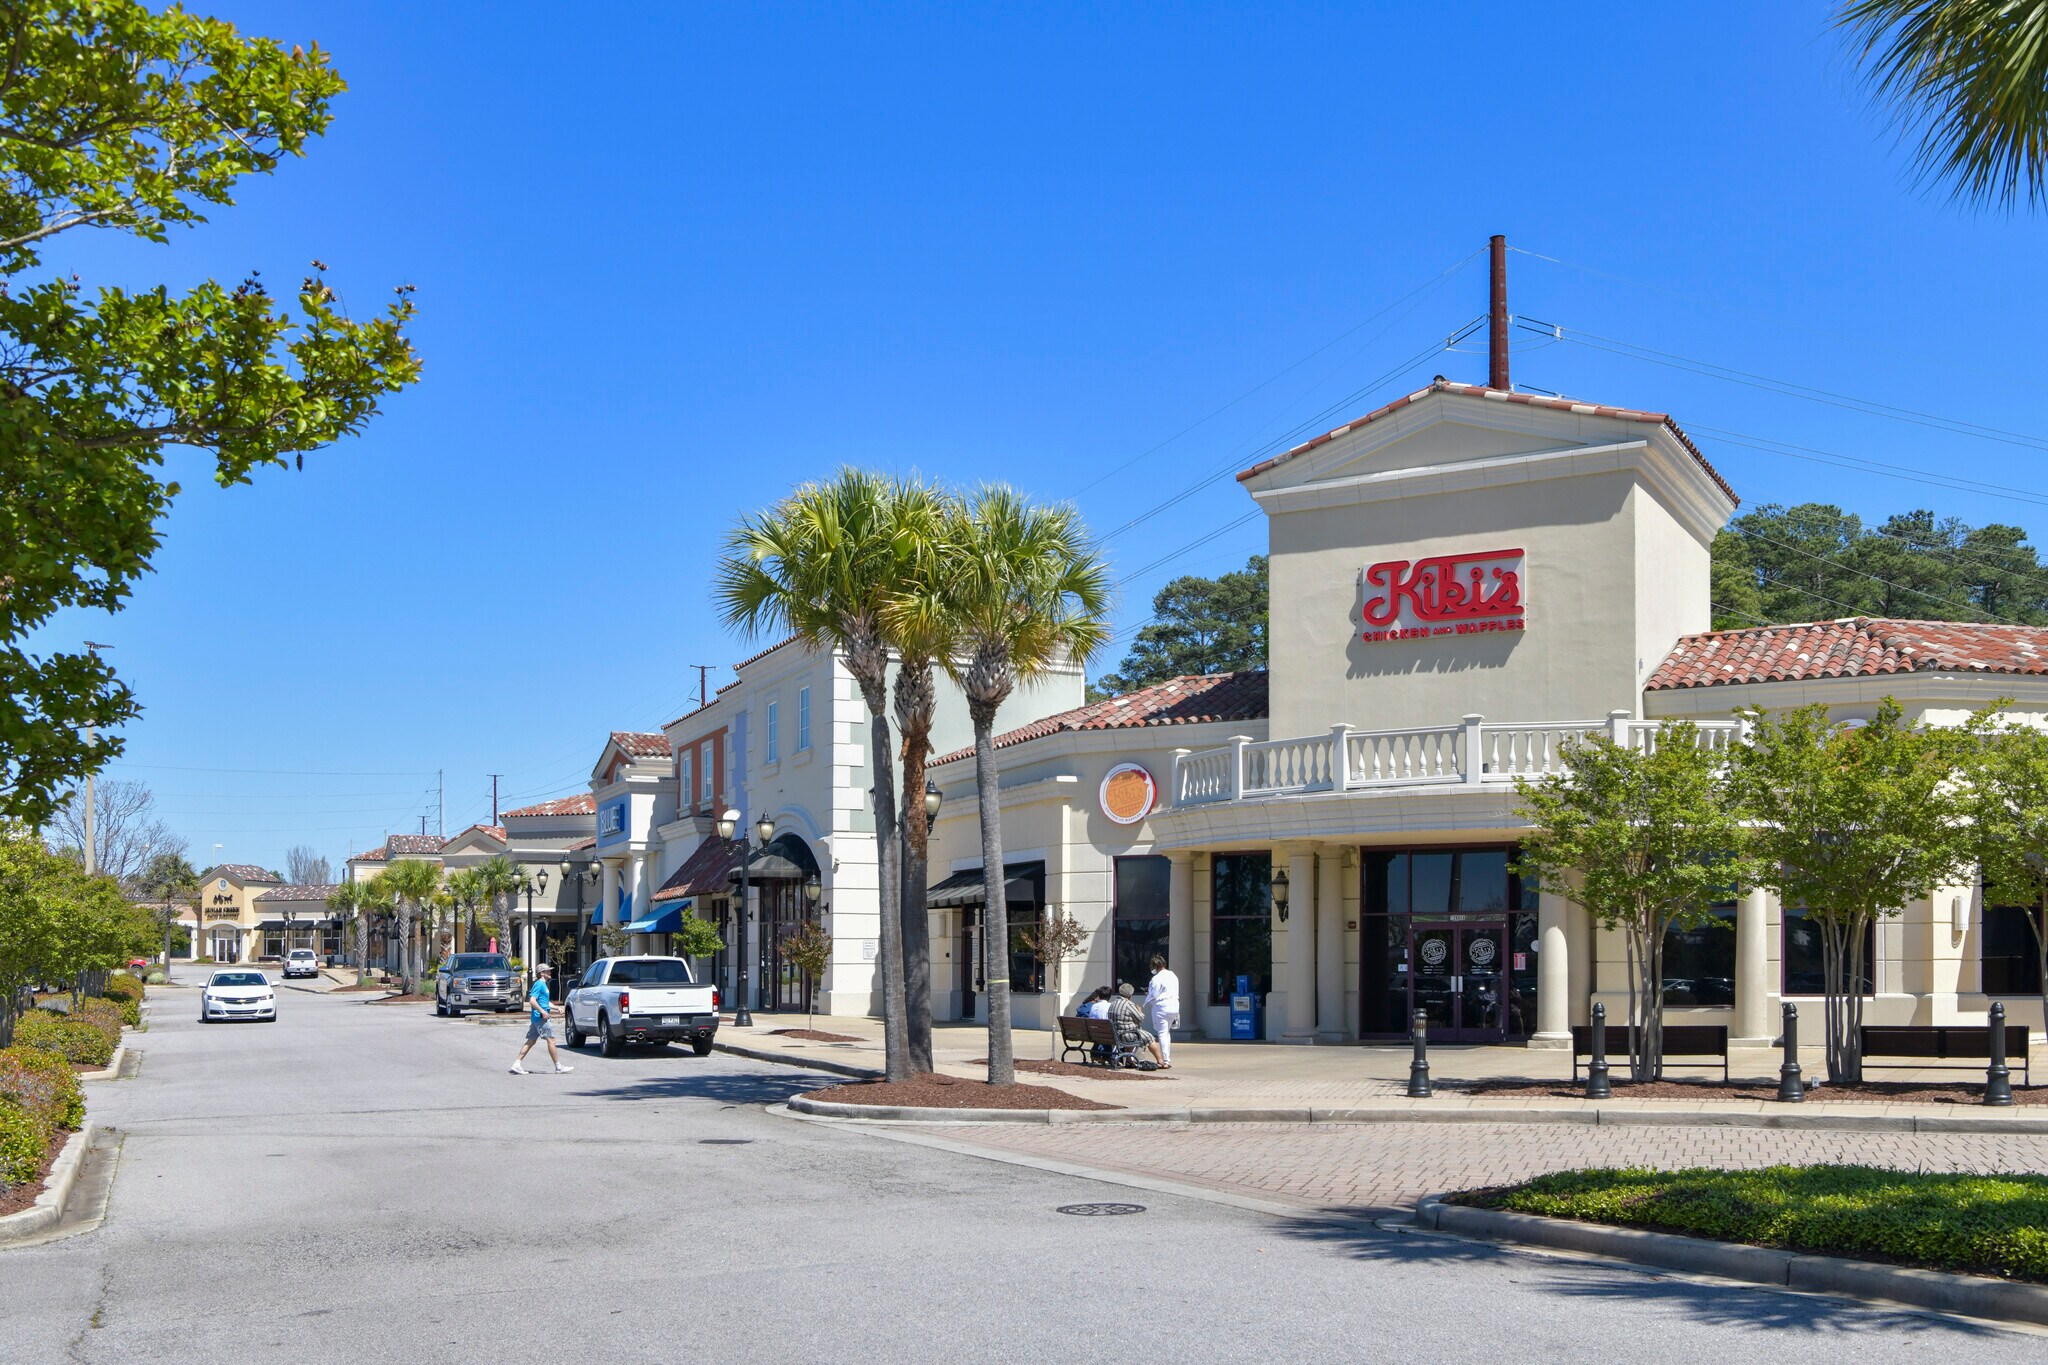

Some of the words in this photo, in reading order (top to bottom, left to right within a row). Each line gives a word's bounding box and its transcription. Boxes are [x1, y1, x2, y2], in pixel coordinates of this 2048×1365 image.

[1363, 548, 1525, 627] Kiki's
[1362, 627, 1430, 643] CHICKEN
[1432, 627, 1453, 635] AND
[1455, 618, 1525, 635] WAFFLES
